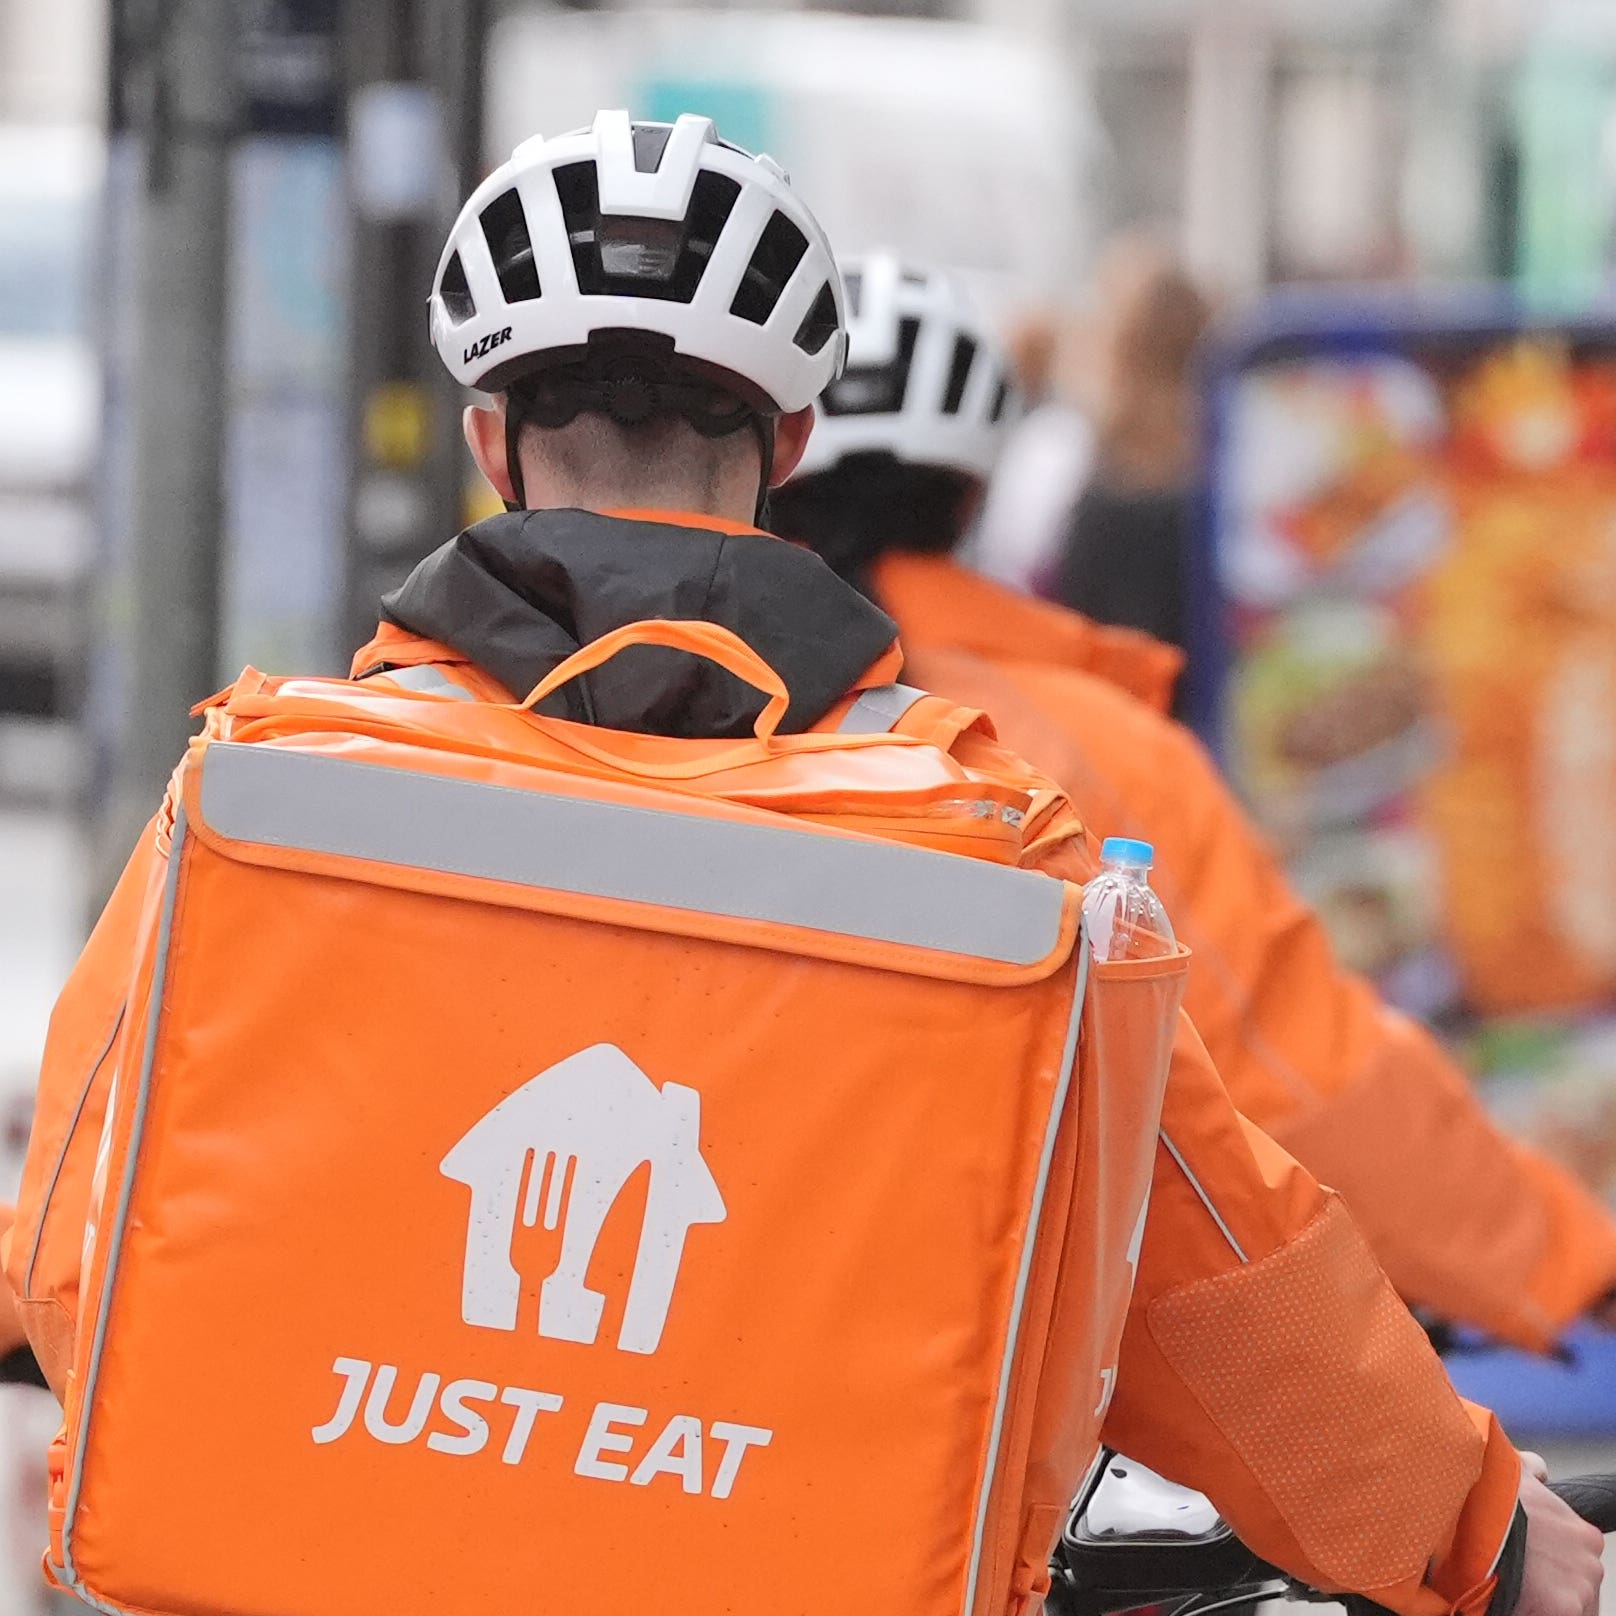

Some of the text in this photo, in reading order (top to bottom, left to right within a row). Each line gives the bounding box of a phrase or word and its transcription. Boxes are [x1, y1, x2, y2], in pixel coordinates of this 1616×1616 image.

[463, 326, 513, 365] LAZER
[311, 1357, 773, 1499] JUST EAT
